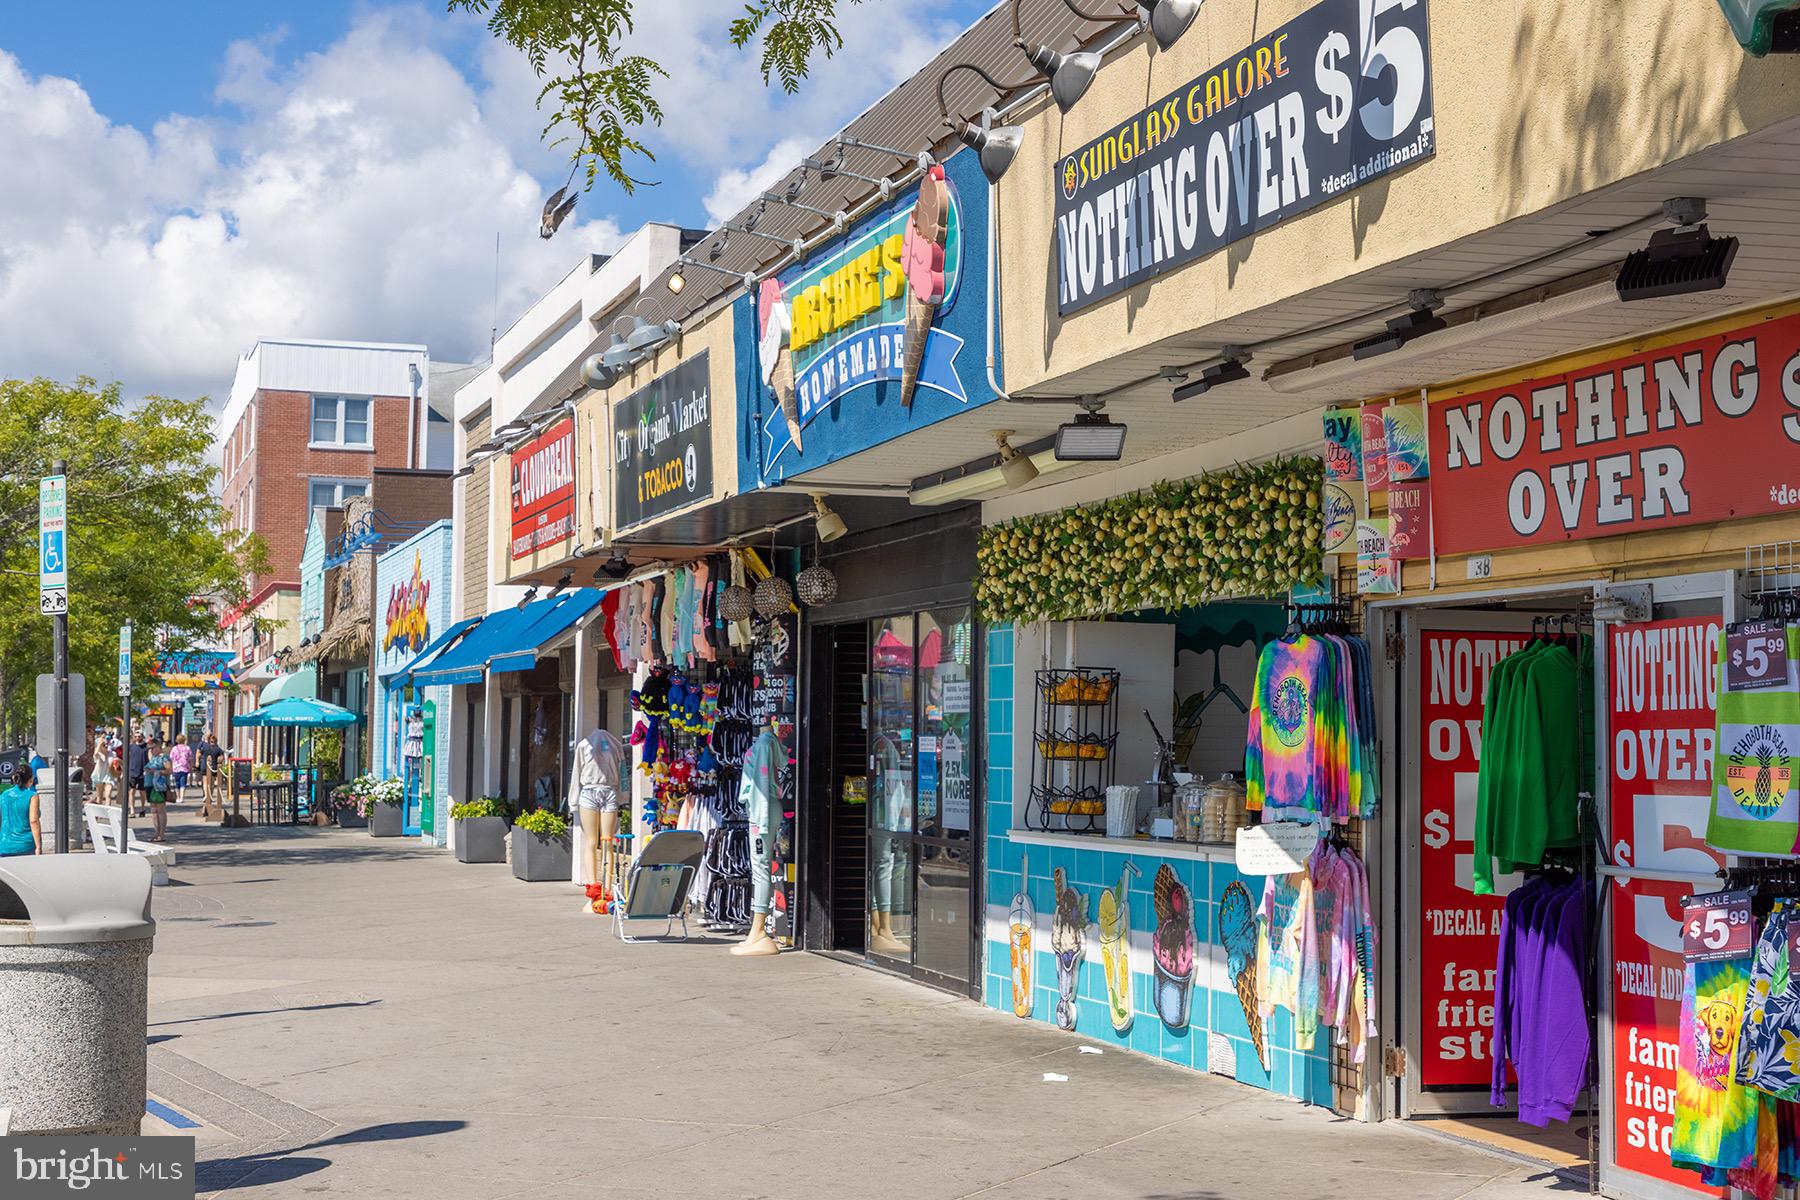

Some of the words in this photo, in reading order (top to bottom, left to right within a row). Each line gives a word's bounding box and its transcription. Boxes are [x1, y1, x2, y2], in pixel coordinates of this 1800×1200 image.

[1080, 96, 1180, 188] SUNGLASS
[1187, 33, 1290, 134] GALORE
[1058, 145, 1198, 304] NOTHING
[1205, 91, 1311, 237] OVER
[799, 333, 904, 417] HOMEMADE
[1445, 336, 1760, 471] NOTHING
[615, 429, 631, 468] City
[638, 406, 671, 457] Organic
[671, 386, 708, 436] Market
[1325, 415, 1353, 443] ay
[520, 432, 573, 508] CLOUDBREAK
[644, 456, 683, 500] TOBACCO
[1506, 445, 1691, 537] OVER
[1394, 489, 1421, 509] BEACH
[1364, 537, 1386, 554] BEACH
[1743, 623, 1767, 635] SALE
[1429, 637, 1528, 707] NOT
[1615, 622, 1719, 713] NOTHING
[1615, 728, 1715, 781] OVER
[1728, 724, 1773, 765] REHOBOTH
[1771, 729, 1791, 766] BEACH
[945, 779, 970, 800] MORE
[1728, 767, 1744, 777] EST.
[1733, 787, 1785, 817] DELAWARE
[1704, 894, 1730, 907] SALE
[1660, 967, 1685, 1001] ADD
